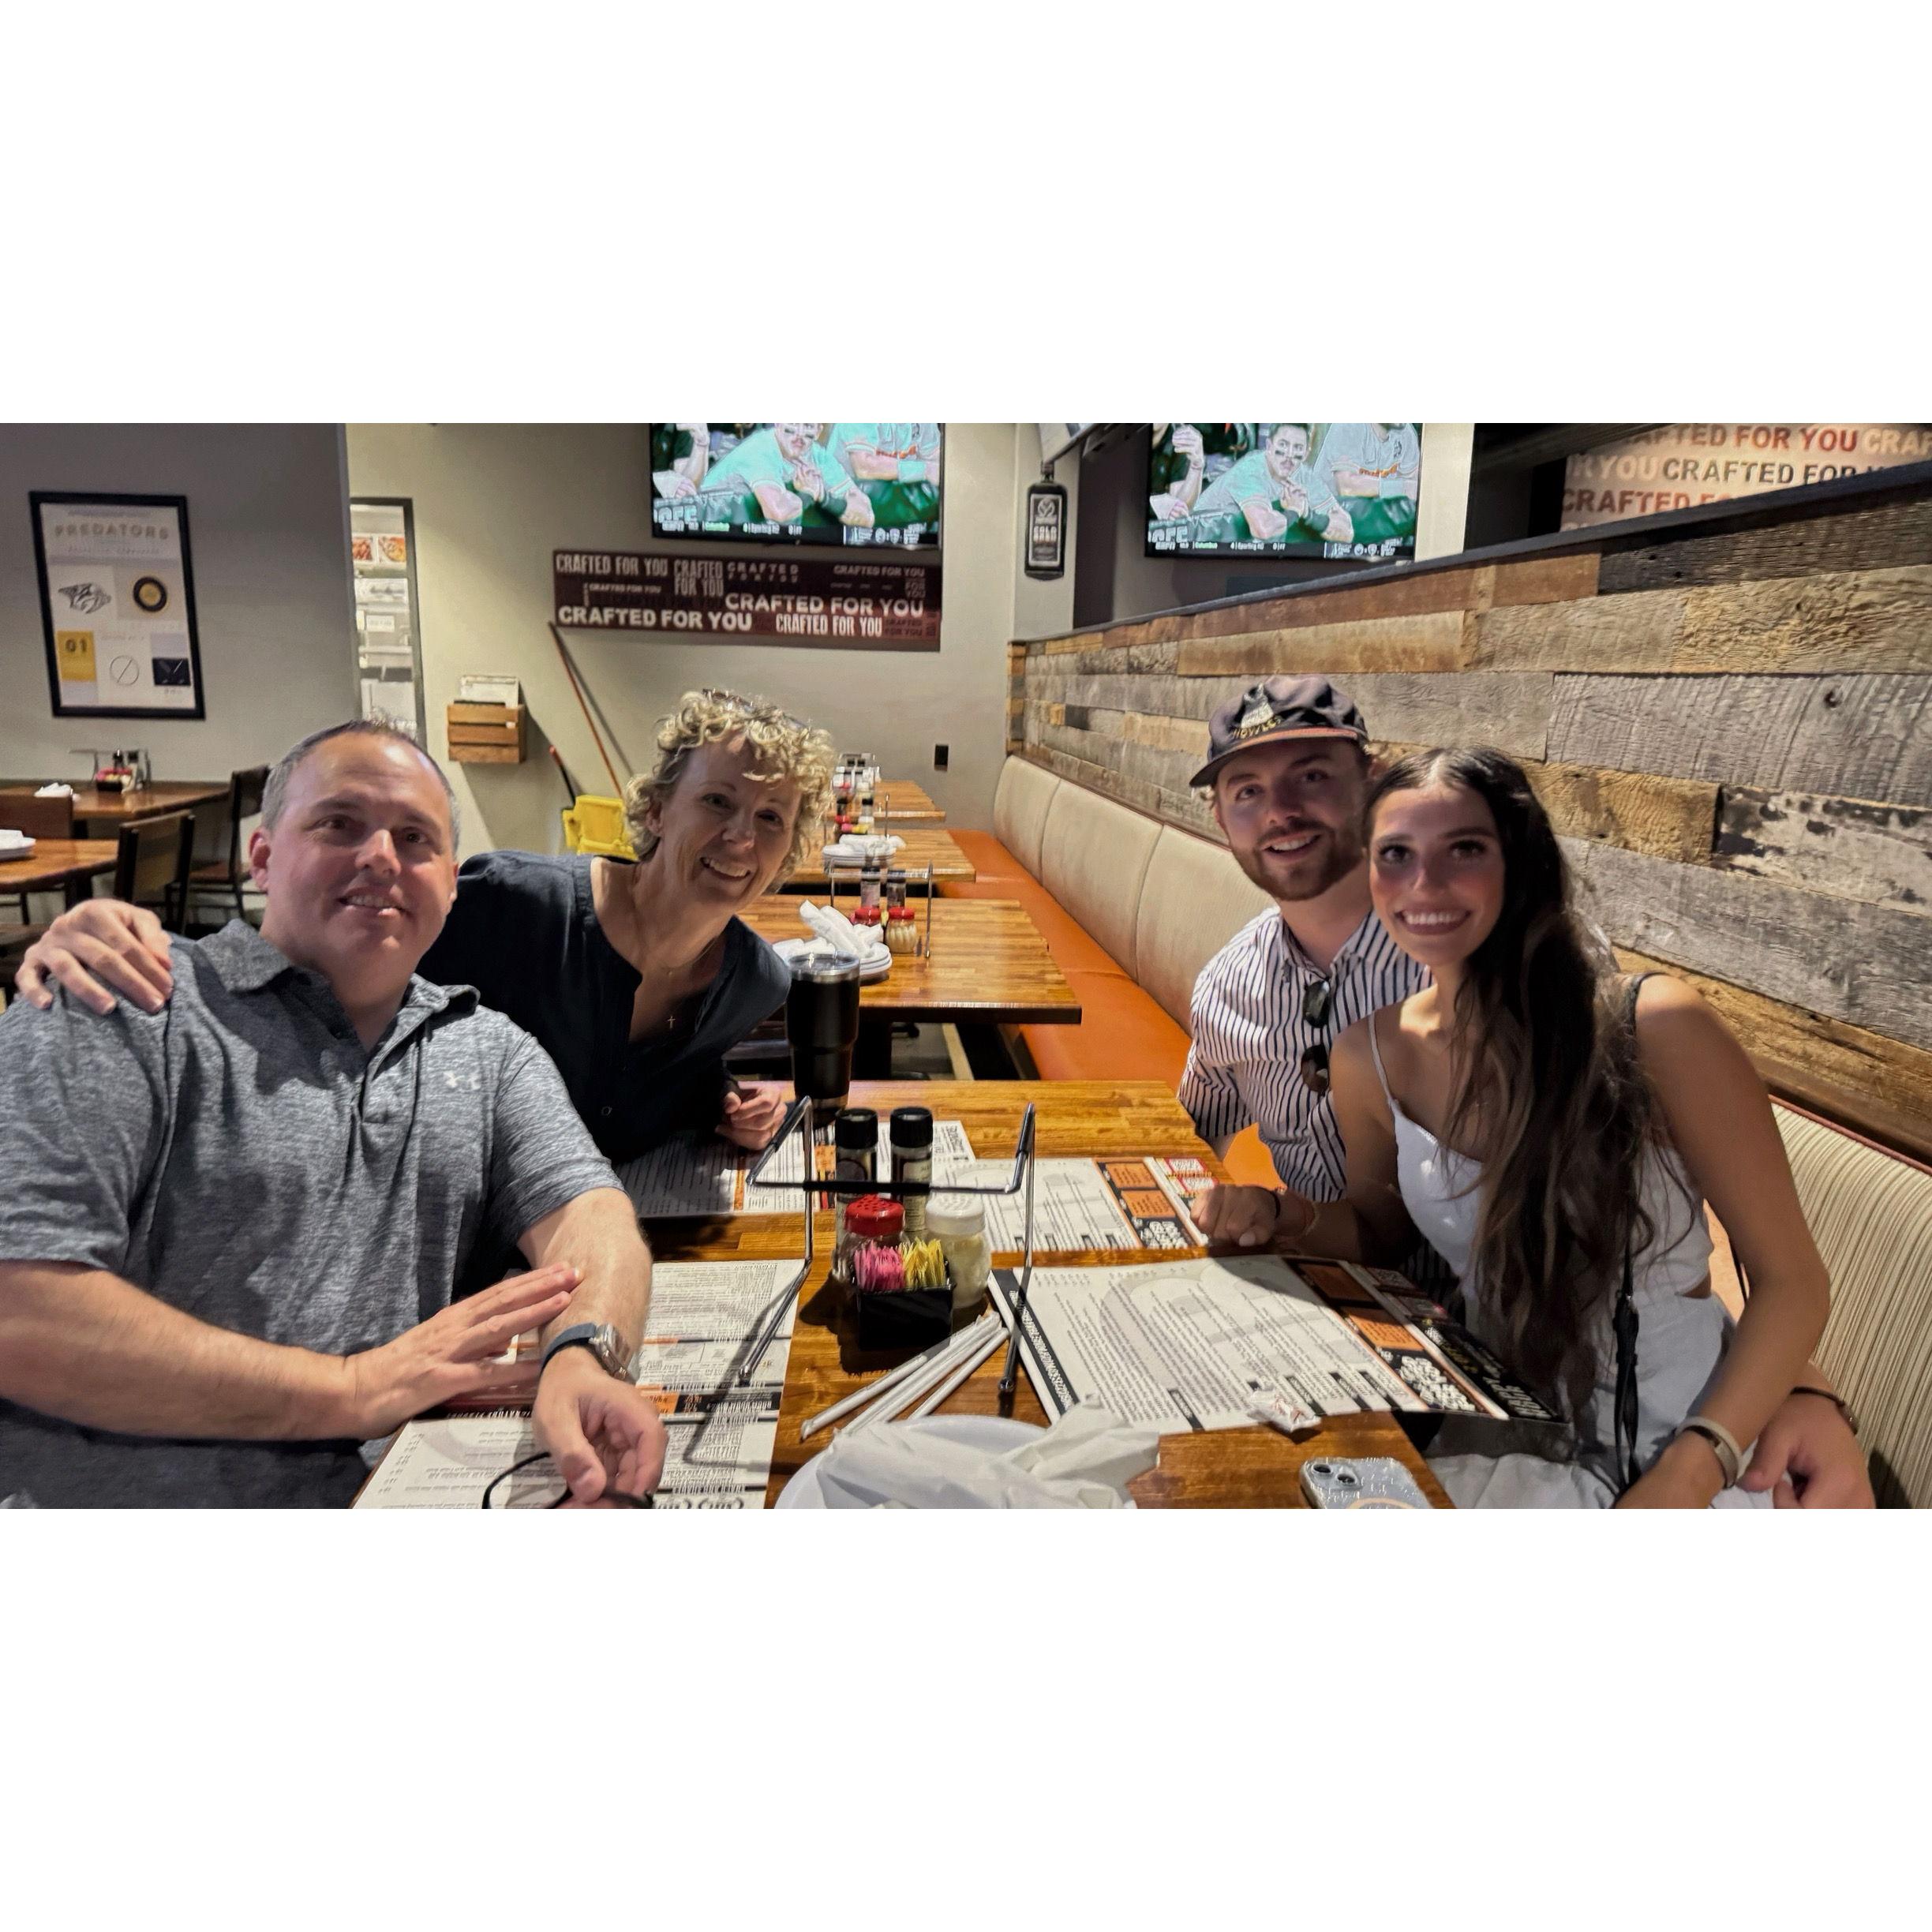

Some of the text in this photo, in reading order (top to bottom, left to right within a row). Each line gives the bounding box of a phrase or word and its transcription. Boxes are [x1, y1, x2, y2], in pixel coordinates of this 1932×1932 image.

[1734, 425, 1791, 450] FOR
[1799, 427, 1858, 452] YOU
[1597, 455, 1657, 481] YOU
[1663, 457, 1794, 484] CRAFTED
[1563, 488, 1690, 514] CRAFTED
[54, 522, 169, 540] PREDATORS
[556, 554, 668, 577] CRAFTED FOR YOU
[673, 560, 723, 578] CRAFTED
[727, 561, 799, 574] CRAFTED
[833, 564, 926, 578] CRAFTED FOR YOU
[674, 576, 724, 597] FOR YOU
[724, 593, 825, 614] CRAFTED
[830, 596, 874, 616] FOR
[879, 597, 924, 618] YOU
[558, 605, 753, 631] CRAFTED FOR YOU
[776, 613, 883, 638] CRAFTED FOR YOU
